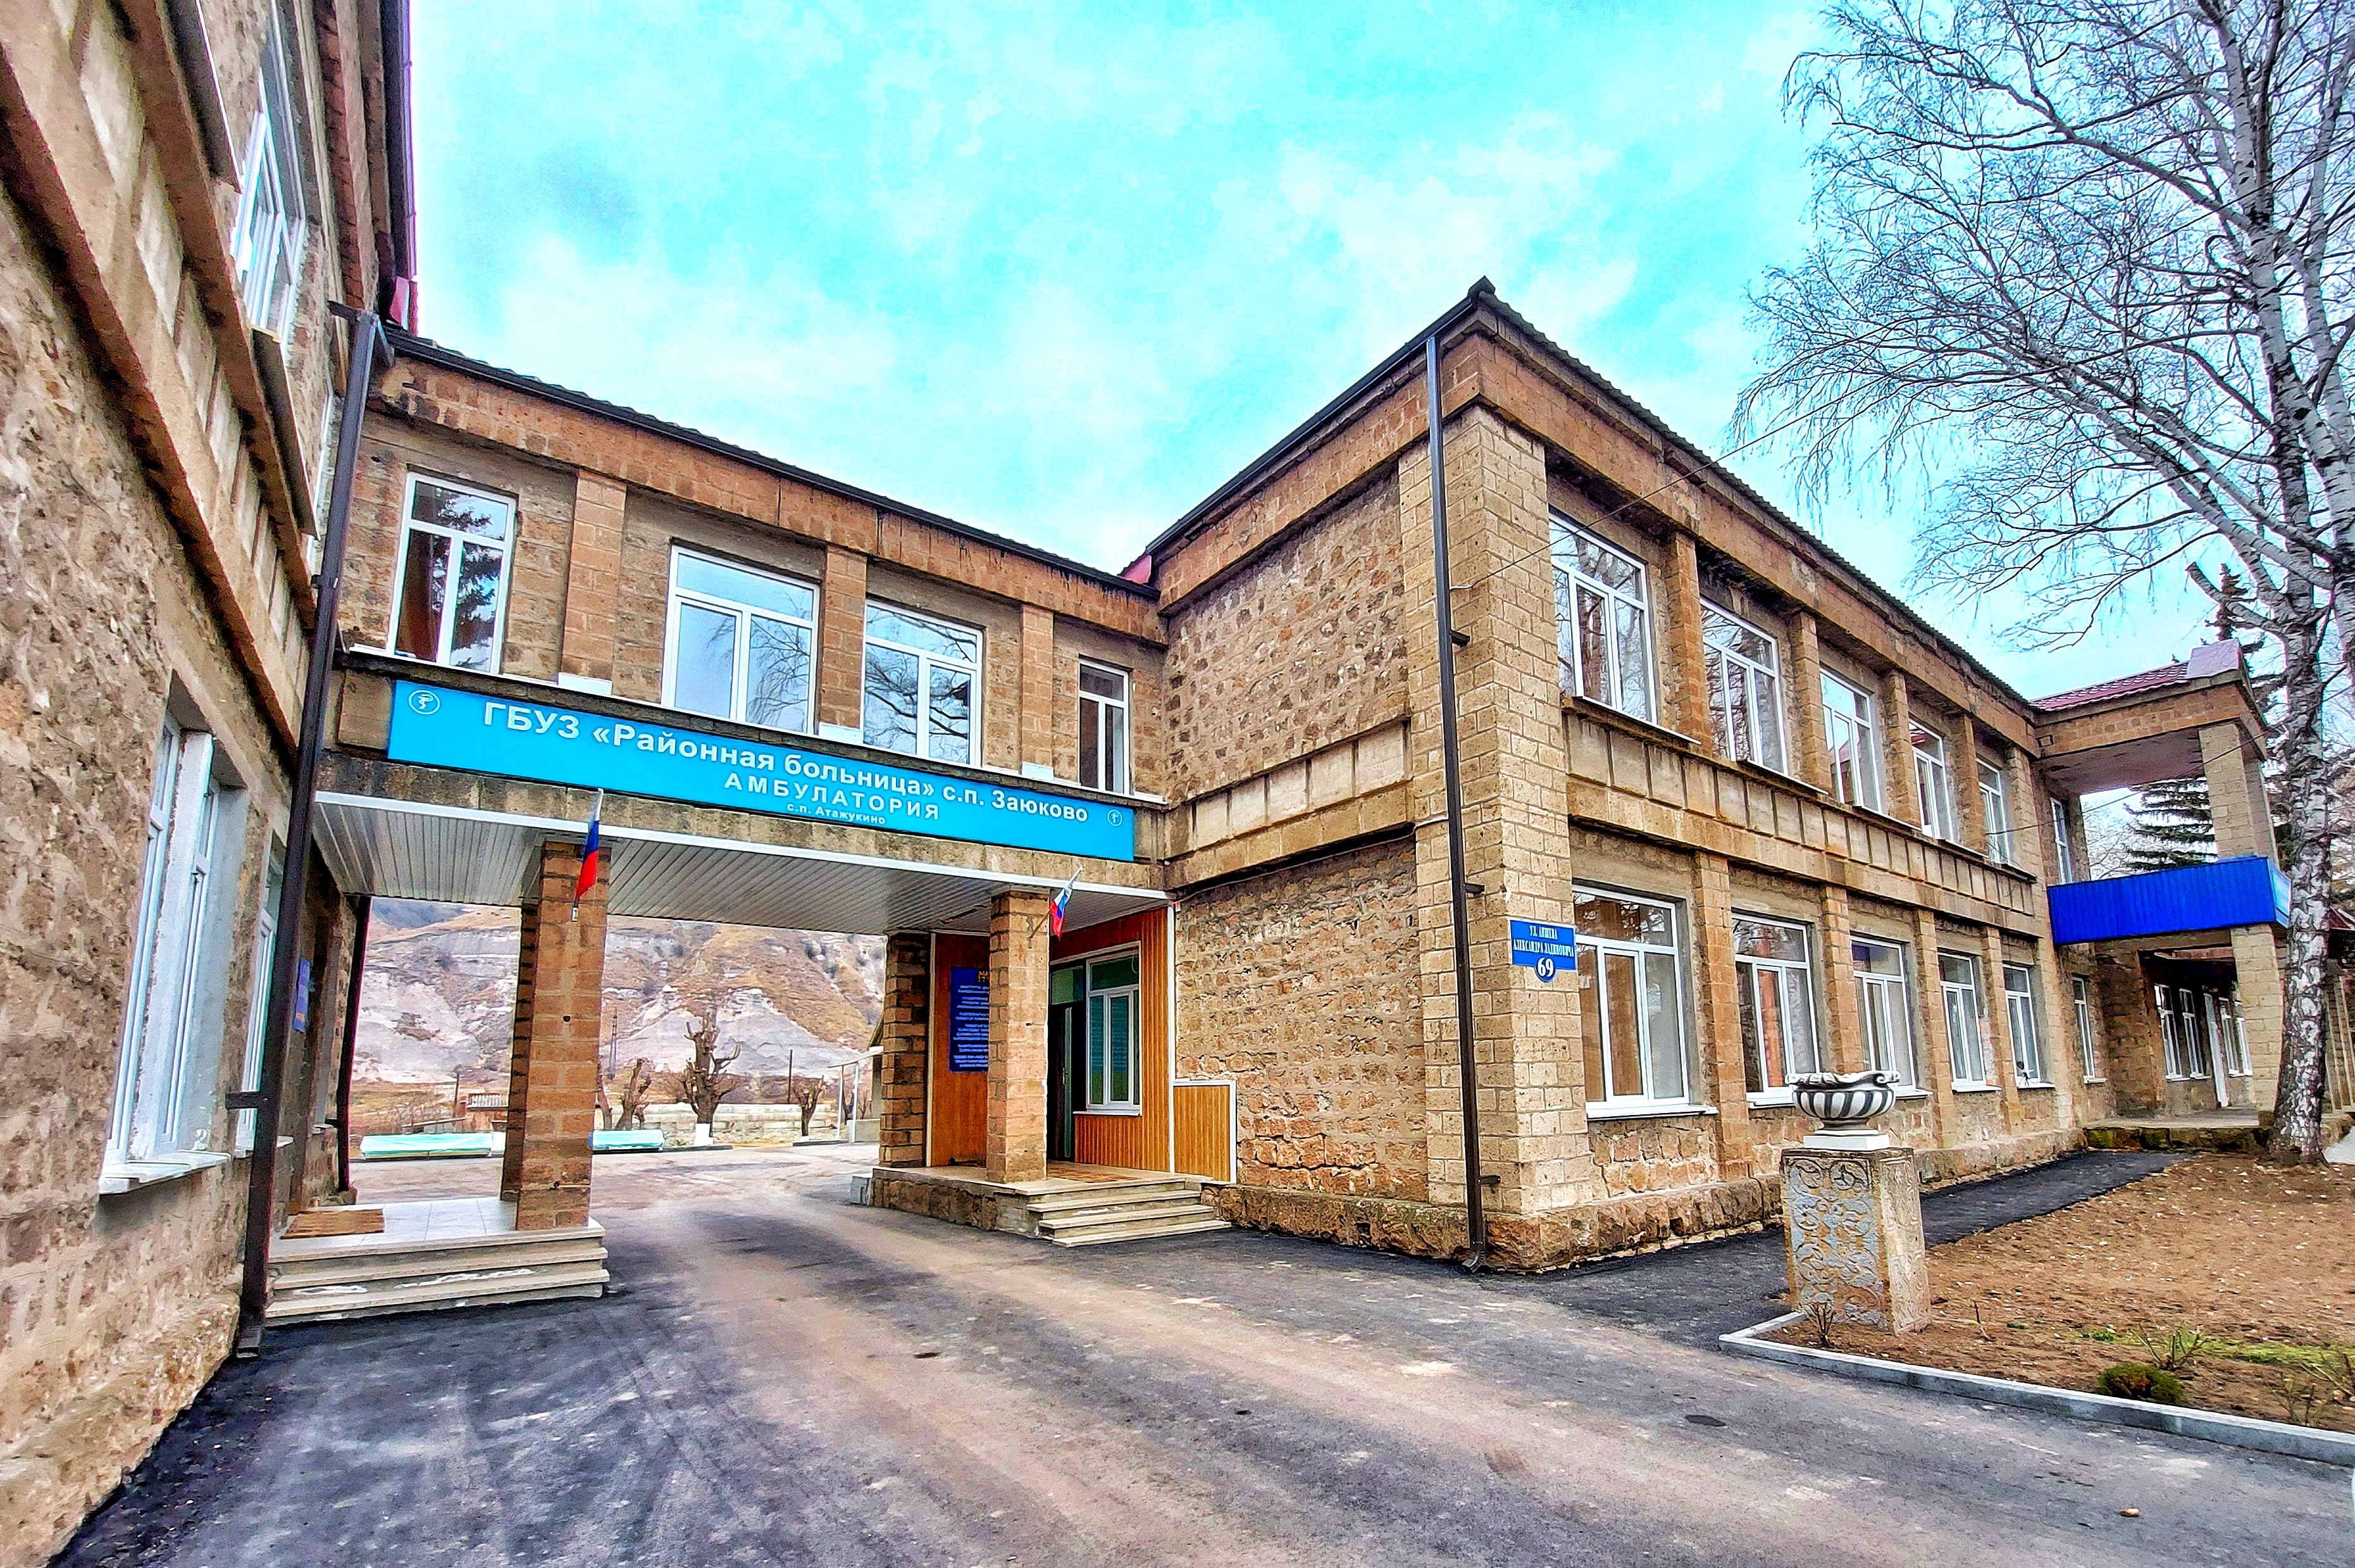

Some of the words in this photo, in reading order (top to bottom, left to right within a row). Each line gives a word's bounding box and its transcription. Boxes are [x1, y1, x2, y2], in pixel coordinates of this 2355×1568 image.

[485, 702, 579, 738] ГБУЗ
[593, 723, 774, 771] «Районная
[785, 755, 935, 796] больница»
[943, 786, 984, 806] с.п.
[991, 790, 1088, 821] Заюково
[724, 773, 938, 819] АМБУЛАТОРИЯ
[787, 804, 811, 814] с.п.
[816, 807, 885, 824] Атажукино
[1529, 925, 1538, 936] УЛ.
[1513, 939, 1543, 954] АЛЕКСАНДРА
[1538, 957, 1554, 977] 69
